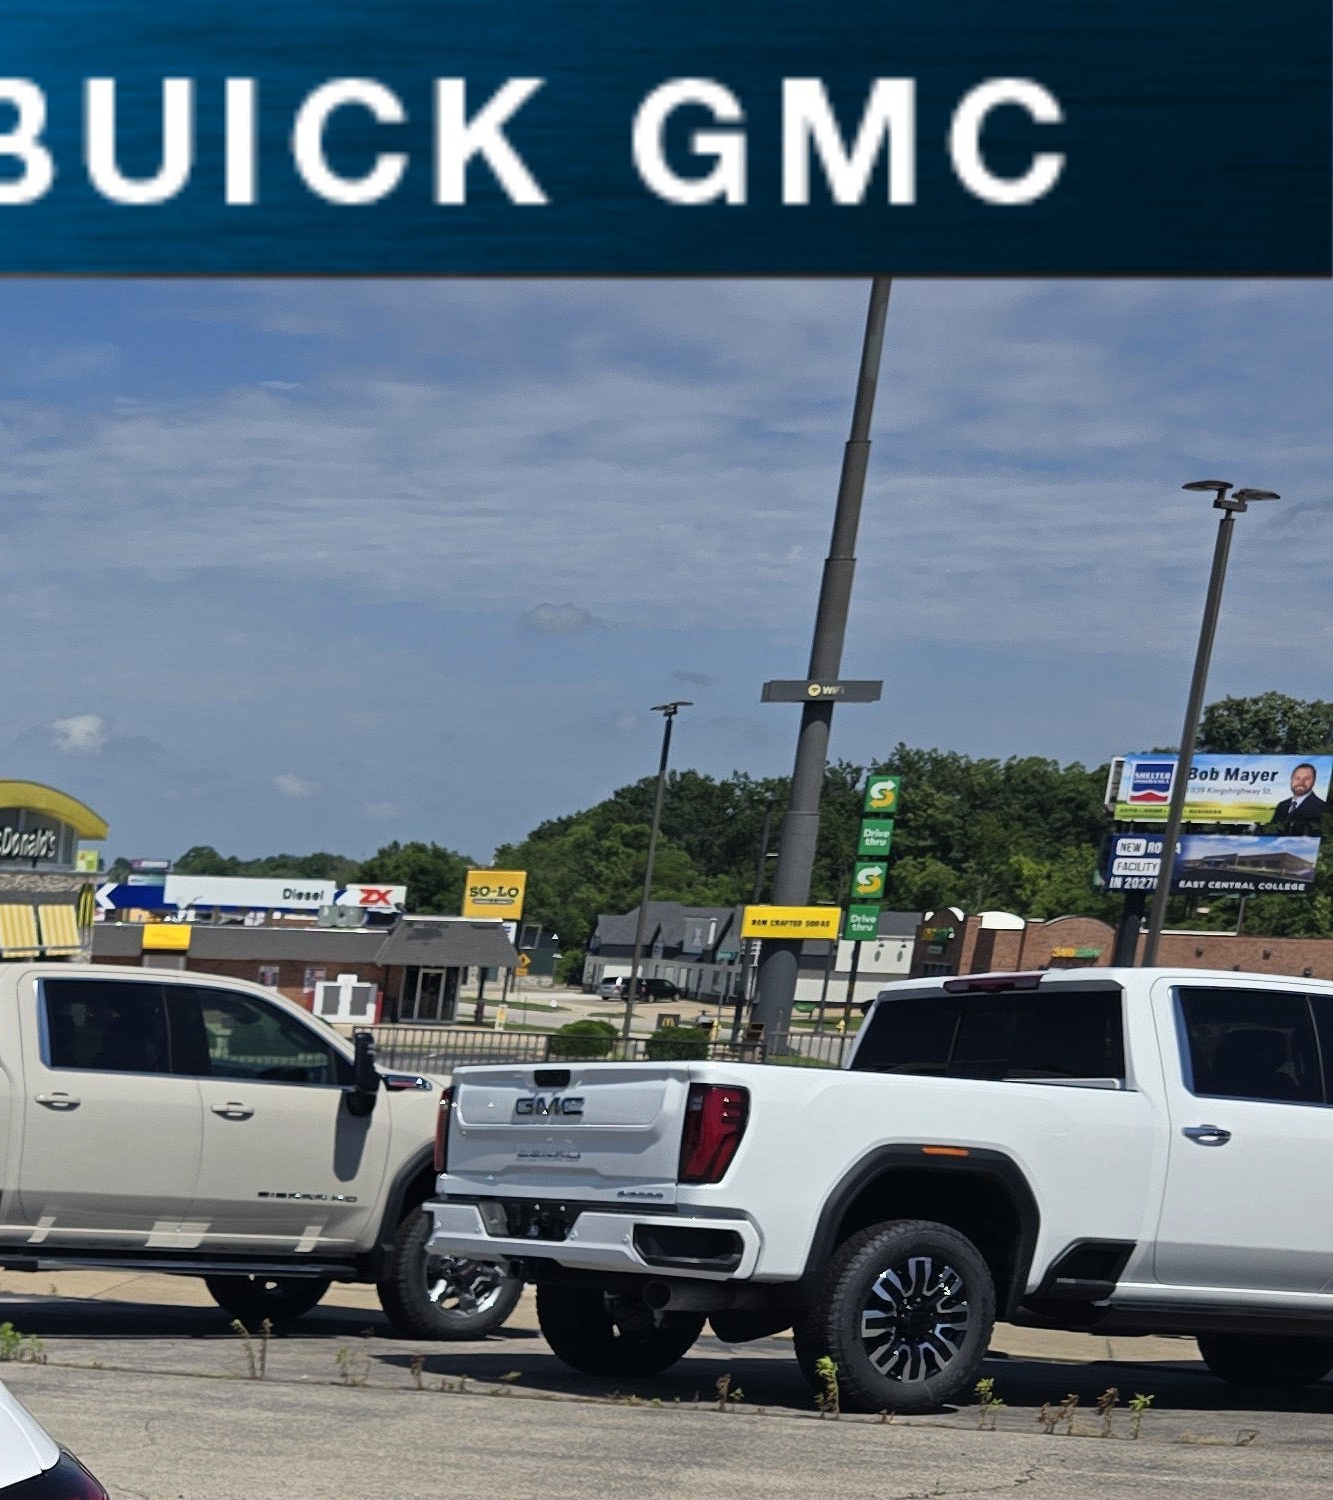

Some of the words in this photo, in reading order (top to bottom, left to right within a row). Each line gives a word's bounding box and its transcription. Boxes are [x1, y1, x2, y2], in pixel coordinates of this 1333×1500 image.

[1188, 767, 1220, 780] Bob
[1224, 768, 1279, 785] Mayer
[863, 828, 890, 838] Drive
[865, 837, 887, 847] thru
[1120, 842, 1142, 852] NEW
[1116, 862, 1158, 872] FACILITY
[1109, 877, 1123, 889] IN
[1178, 880, 1206, 888] EAST
[1207, 881, 1255, 890] CENTRAL
[1258, 883, 1306, 891] COLLEGE
[282, 888, 325, 901] Diesel
[849, 914, 877, 923] Drive
[852, 922, 873, 932] thru
[515, 1097, 584, 1115] GMC
